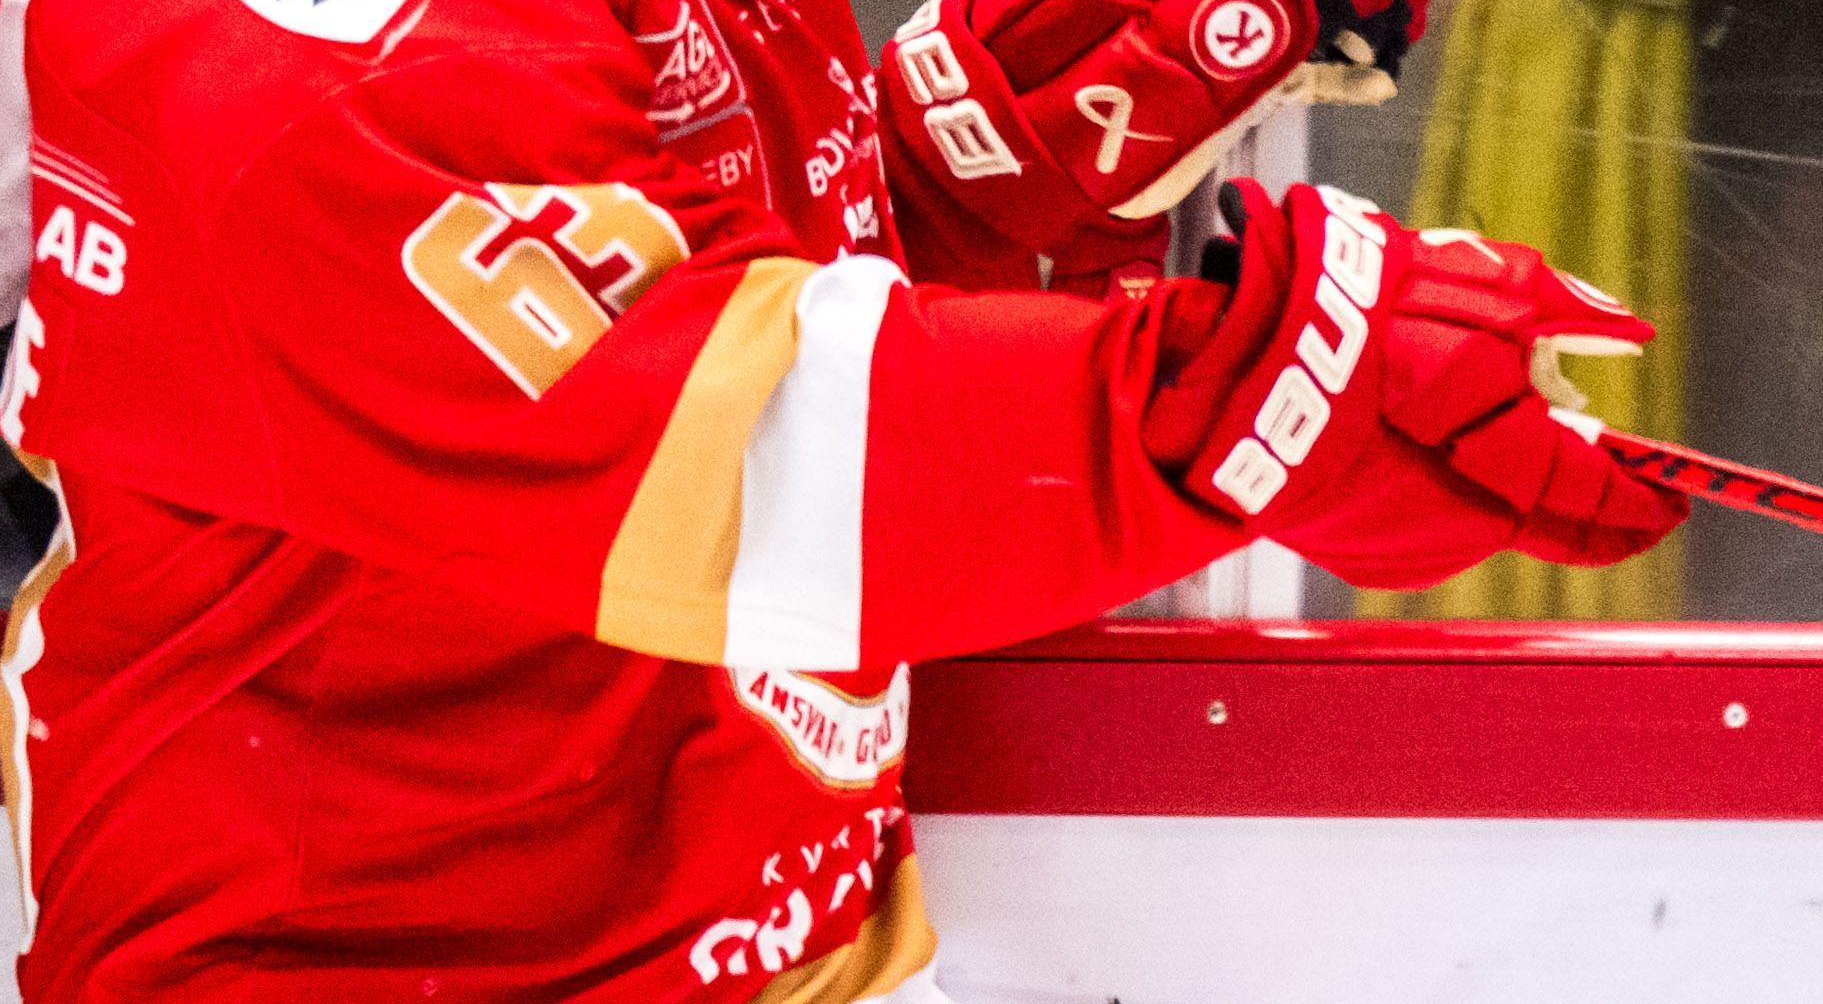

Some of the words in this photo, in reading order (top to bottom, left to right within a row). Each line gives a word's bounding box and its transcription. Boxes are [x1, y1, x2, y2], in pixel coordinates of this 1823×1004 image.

[36, 204, 128, 297] AB
[401, 181, 692, 402] 63
[1212, 184, 1387, 516] BAUER
